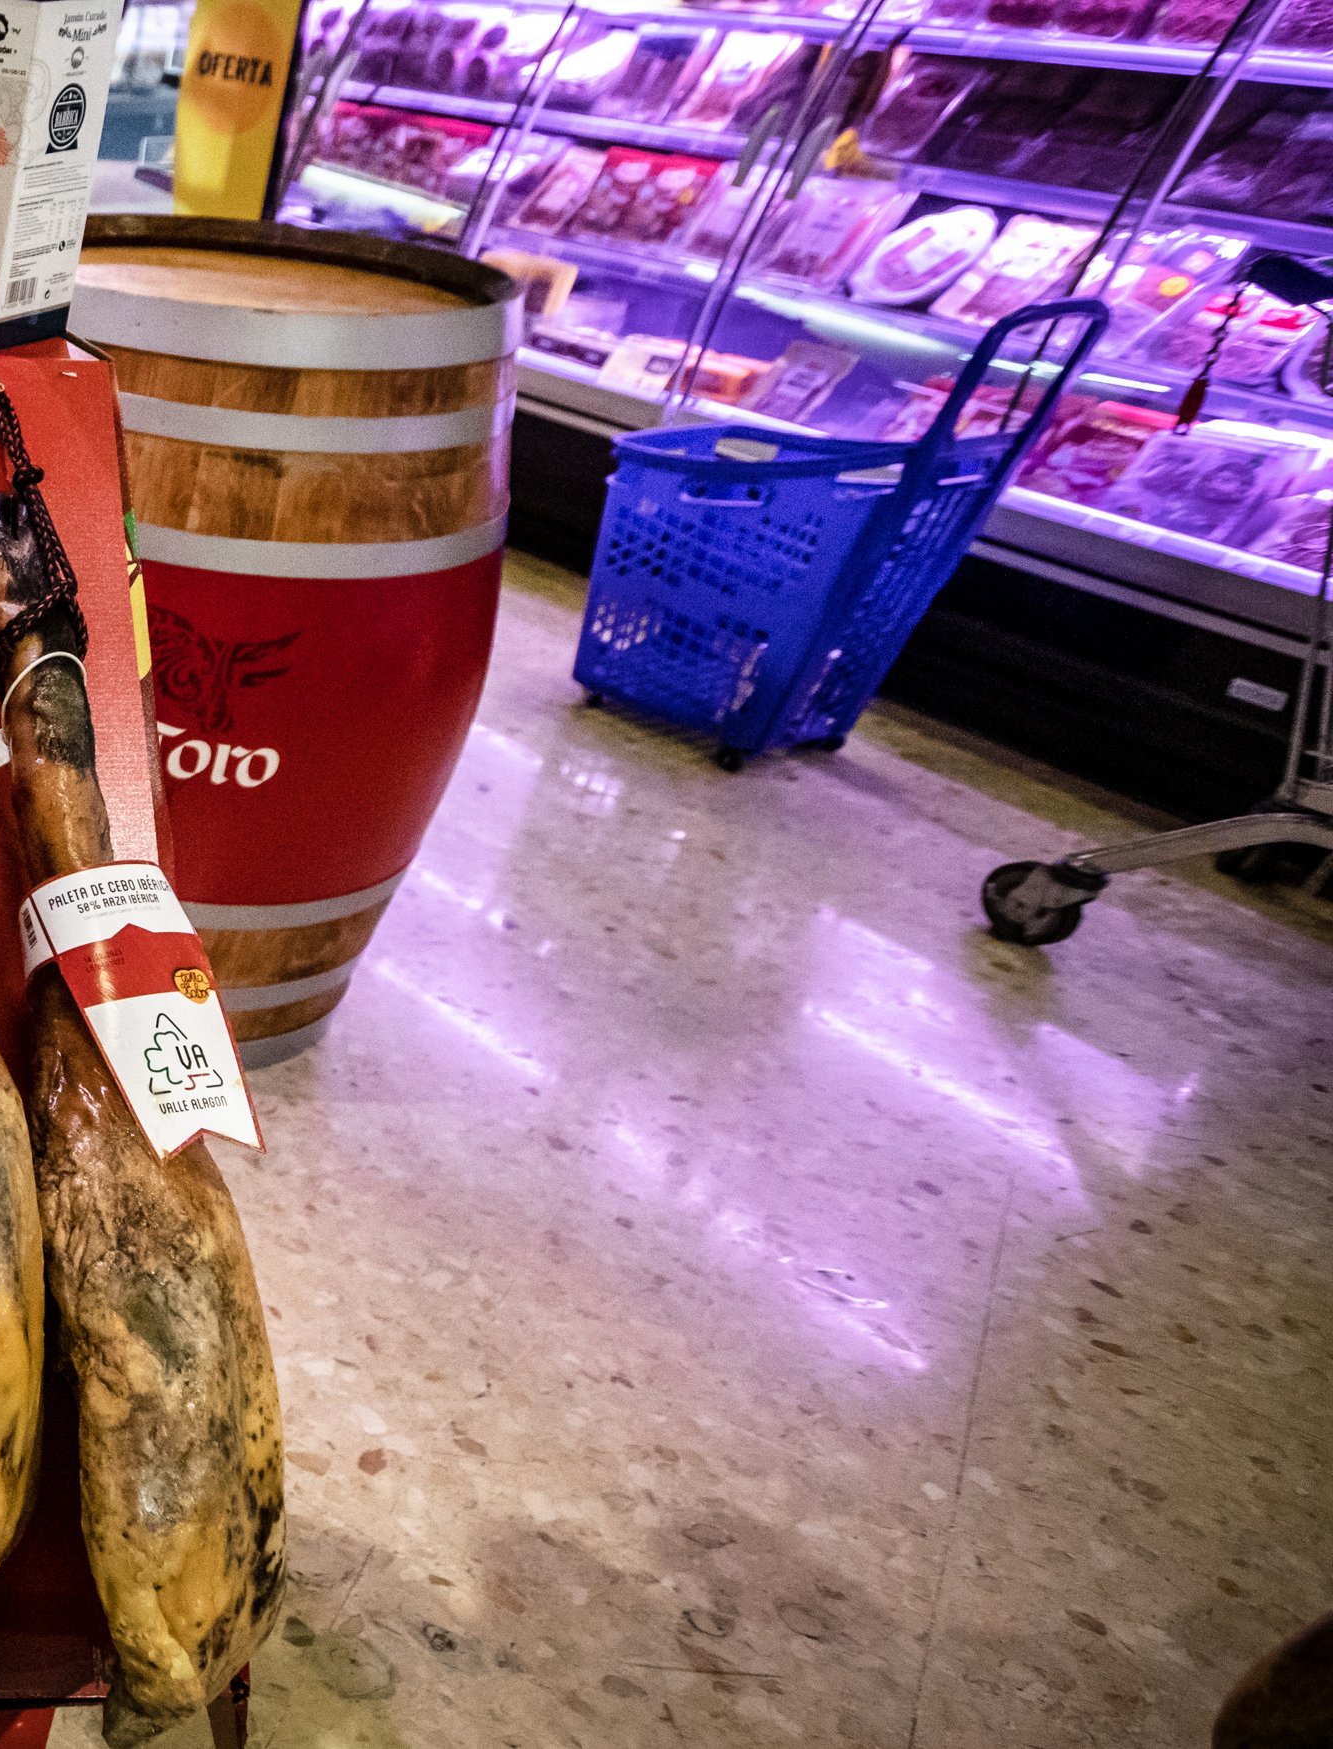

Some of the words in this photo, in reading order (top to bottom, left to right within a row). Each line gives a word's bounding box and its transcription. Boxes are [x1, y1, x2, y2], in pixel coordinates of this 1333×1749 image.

[64, 12, 84, 25] Jamón
[85, 11, 108, 21] Curado
[72, 28, 92, 43] Mini
[197, 50, 273, 87] OFERTA
[55, 109, 79, 128] BARRICA
[48, 887, 88, 911] PALETA
[90, 883, 106, 896] DE
[107, 879, 137, 893] CEBO
[77, 900, 102, 914] 50%
[102, 896, 127, 908] RAZA
[128, 891, 160, 904] IBÉRICA
[176, 1044, 209, 1070] VA
[159, 1098, 190, 1115] VALLE
[191, 1095, 228, 1111] ALAGON
